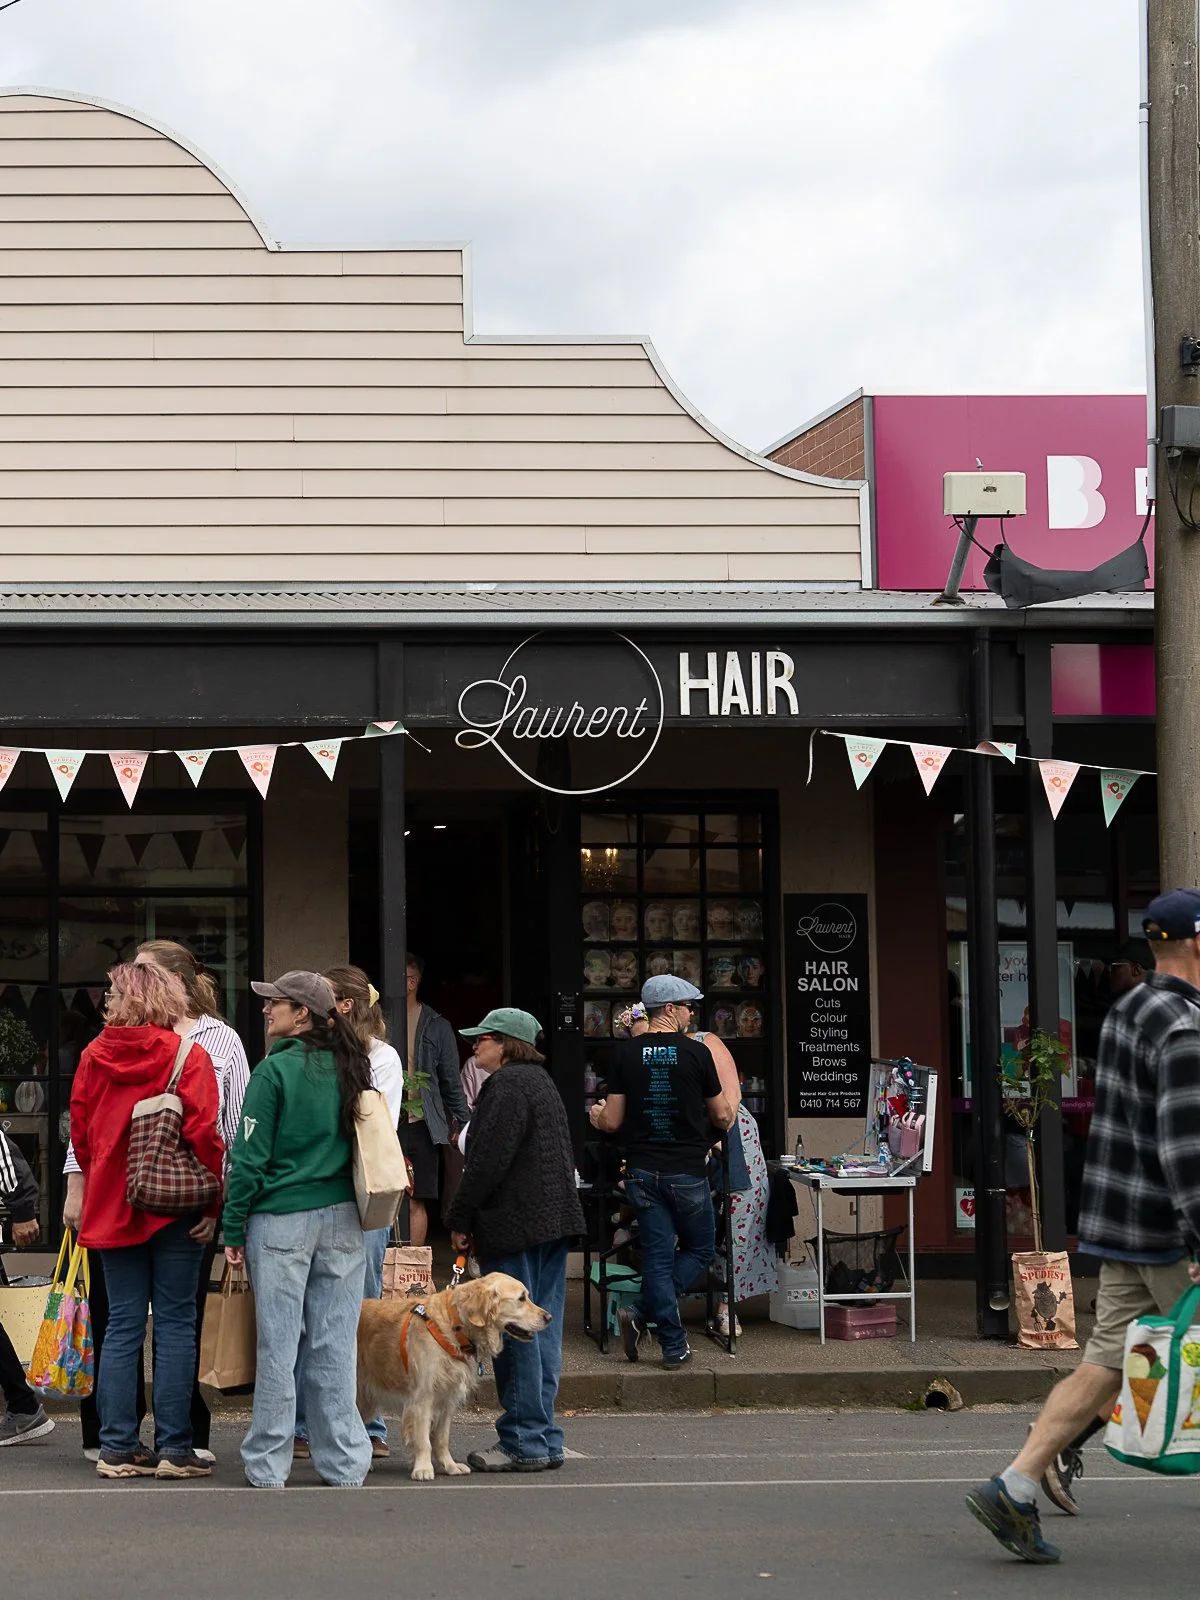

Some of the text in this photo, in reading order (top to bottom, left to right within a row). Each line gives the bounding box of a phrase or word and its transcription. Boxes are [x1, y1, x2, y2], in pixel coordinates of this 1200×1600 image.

[679, 651, 799, 715] HAIR
[455, 675, 649, 749] Laurent
[796, 916, 853, 936] Laurent
[805, 961, 849, 975] HAIR
[797, 978, 858, 992] SALON
[815, 998, 841, 1008] Cuts
[810, 1013, 847, 1023] Colour
[810, 1026, 848, 1040] Styling
[642, 1046, 678, 1056] RIDE
[799, 1042, 860, 1052] Treatments
[812, 1056, 847, 1067] Brows
[802, 1071, 858, 1084] Weddings
[800, 1099, 861, 1108] 0410 714 567
[399, 1273, 432, 1284] SPUDF
